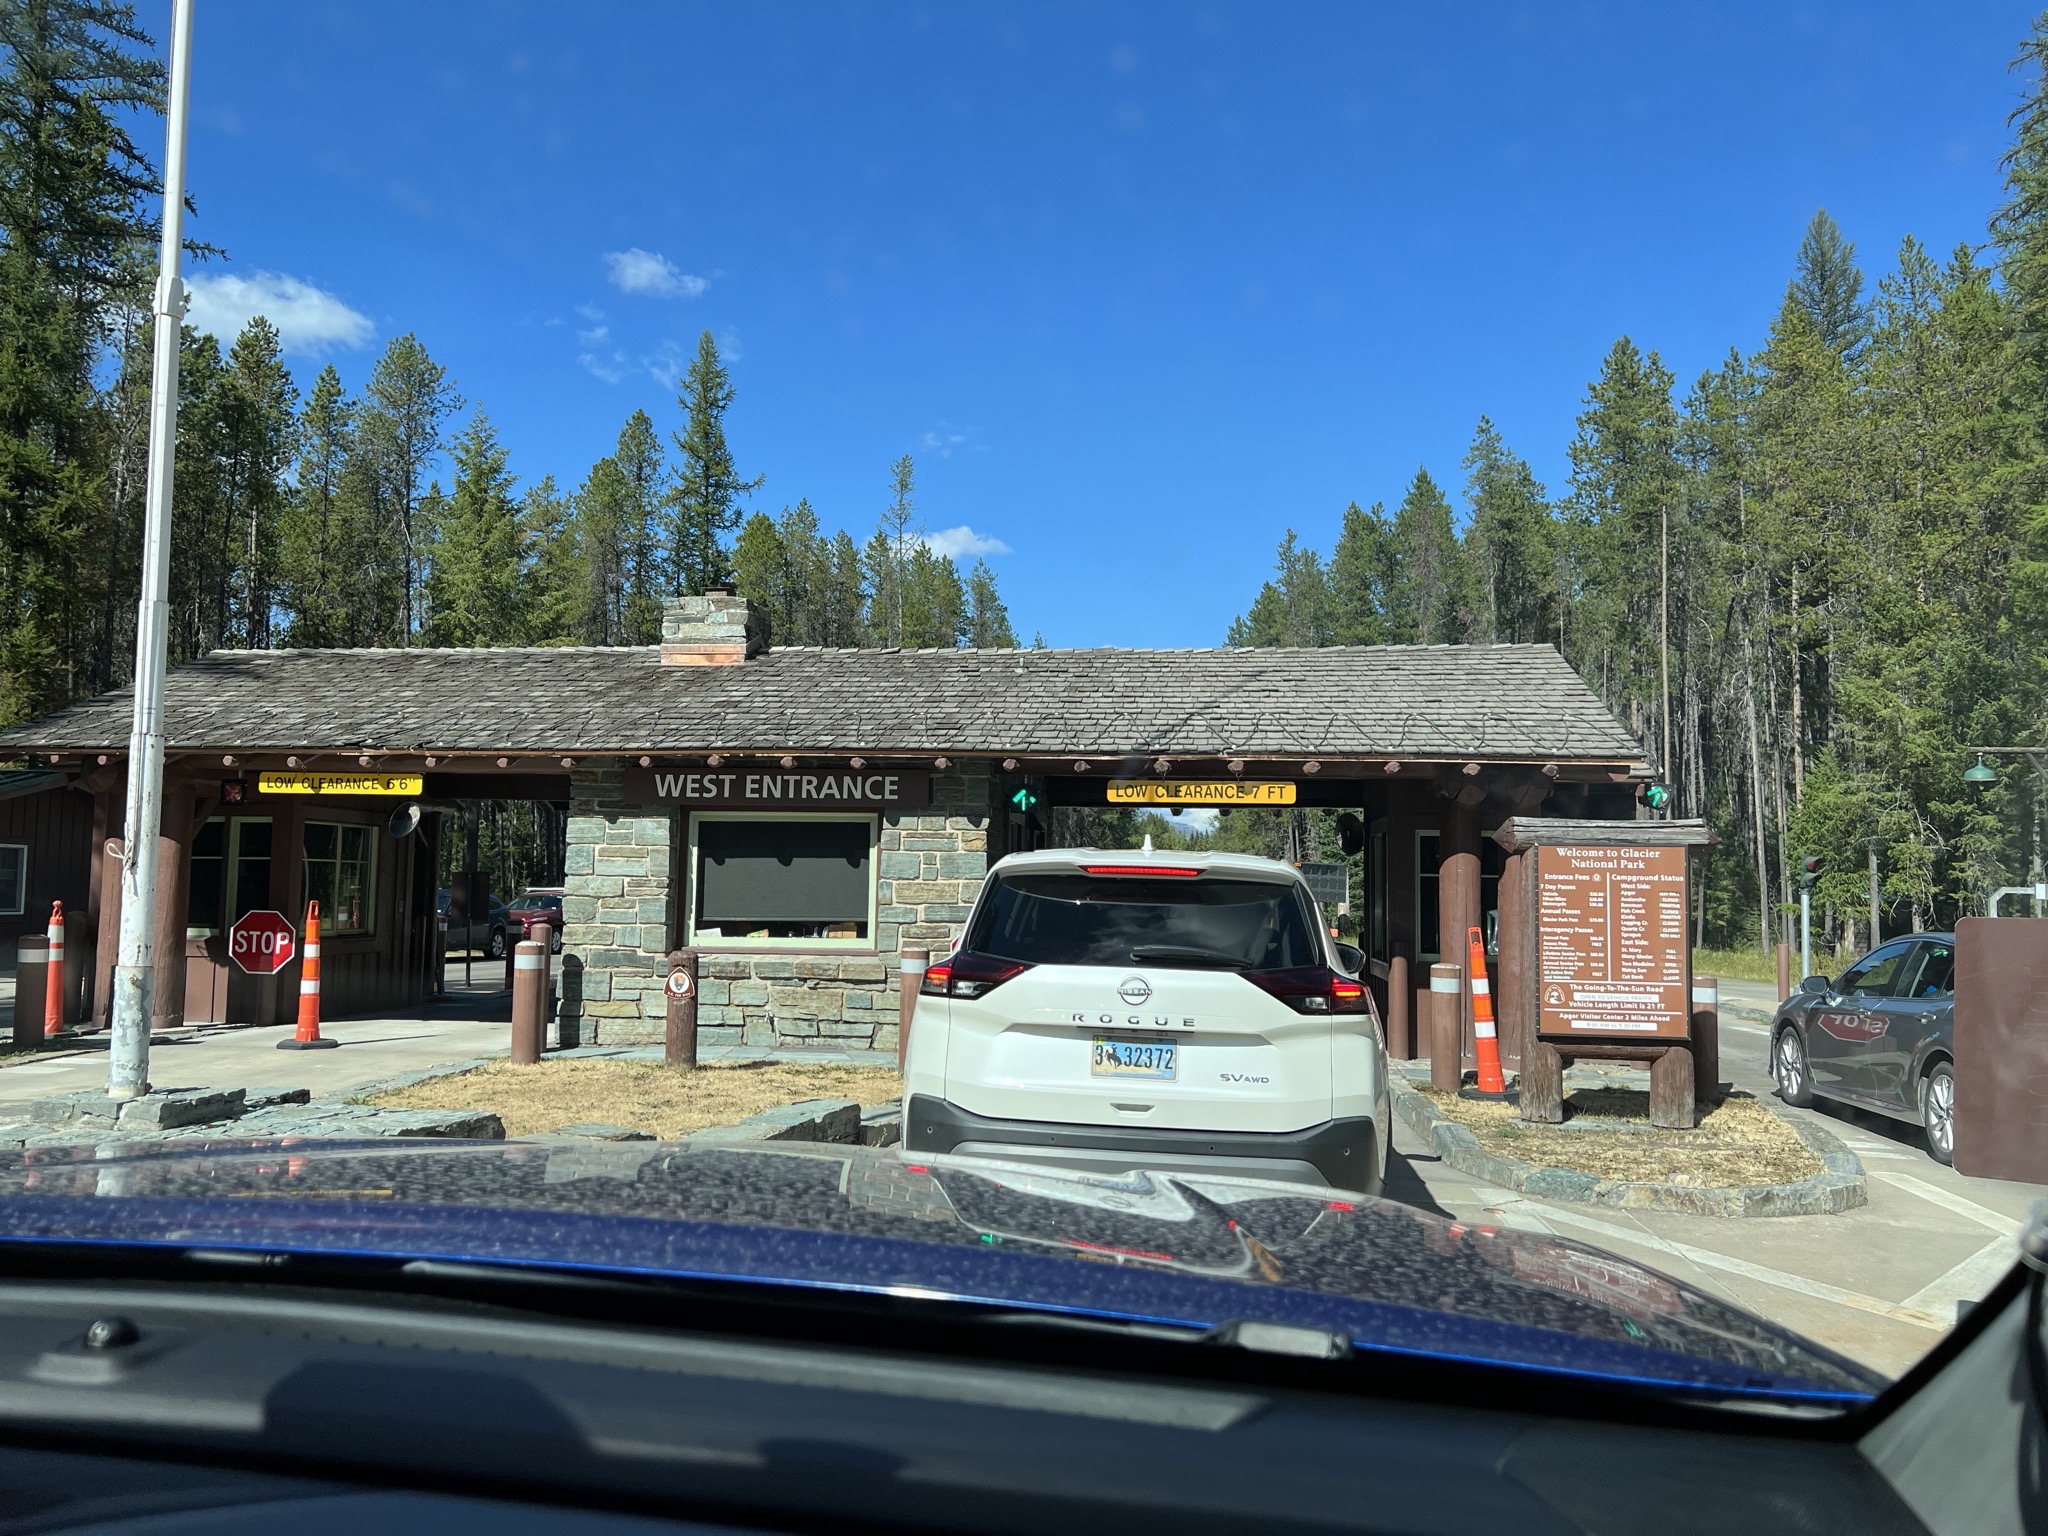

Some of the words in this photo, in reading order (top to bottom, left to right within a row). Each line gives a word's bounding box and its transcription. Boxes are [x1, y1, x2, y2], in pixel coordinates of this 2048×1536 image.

[267, 777, 296, 788] LOW
[301, 778, 379, 789] CLEARANCE
[655, 774, 736, 798] WEST
[745, 775, 899, 799] ENTRANCE
[1115, 785, 1148, 797] LOW
[1155, 785, 1245, 798] CLEARANCE
[1252, 785, 1260, 798] 7
[1267, 785, 1286, 799] FT
[1556, 848, 1604, 857] Welcome
[1621, 849, 1660, 858] Glacier
[1571, 859, 1617, 868] National
[1620, 860, 1645, 868] Park
[1612, 874, 1658, 882] Campground
[234, 930, 290, 954] STOP
[1117, 988, 1152, 996] NISSAN
[1584, 984, 1644, 992] Going-To-The-Sun
[1072, 1013, 1195, 1027] ROGUE
[1095, 1045, 1103, 1065] 3
[1124, 1046, 1173, 1069] 32372
